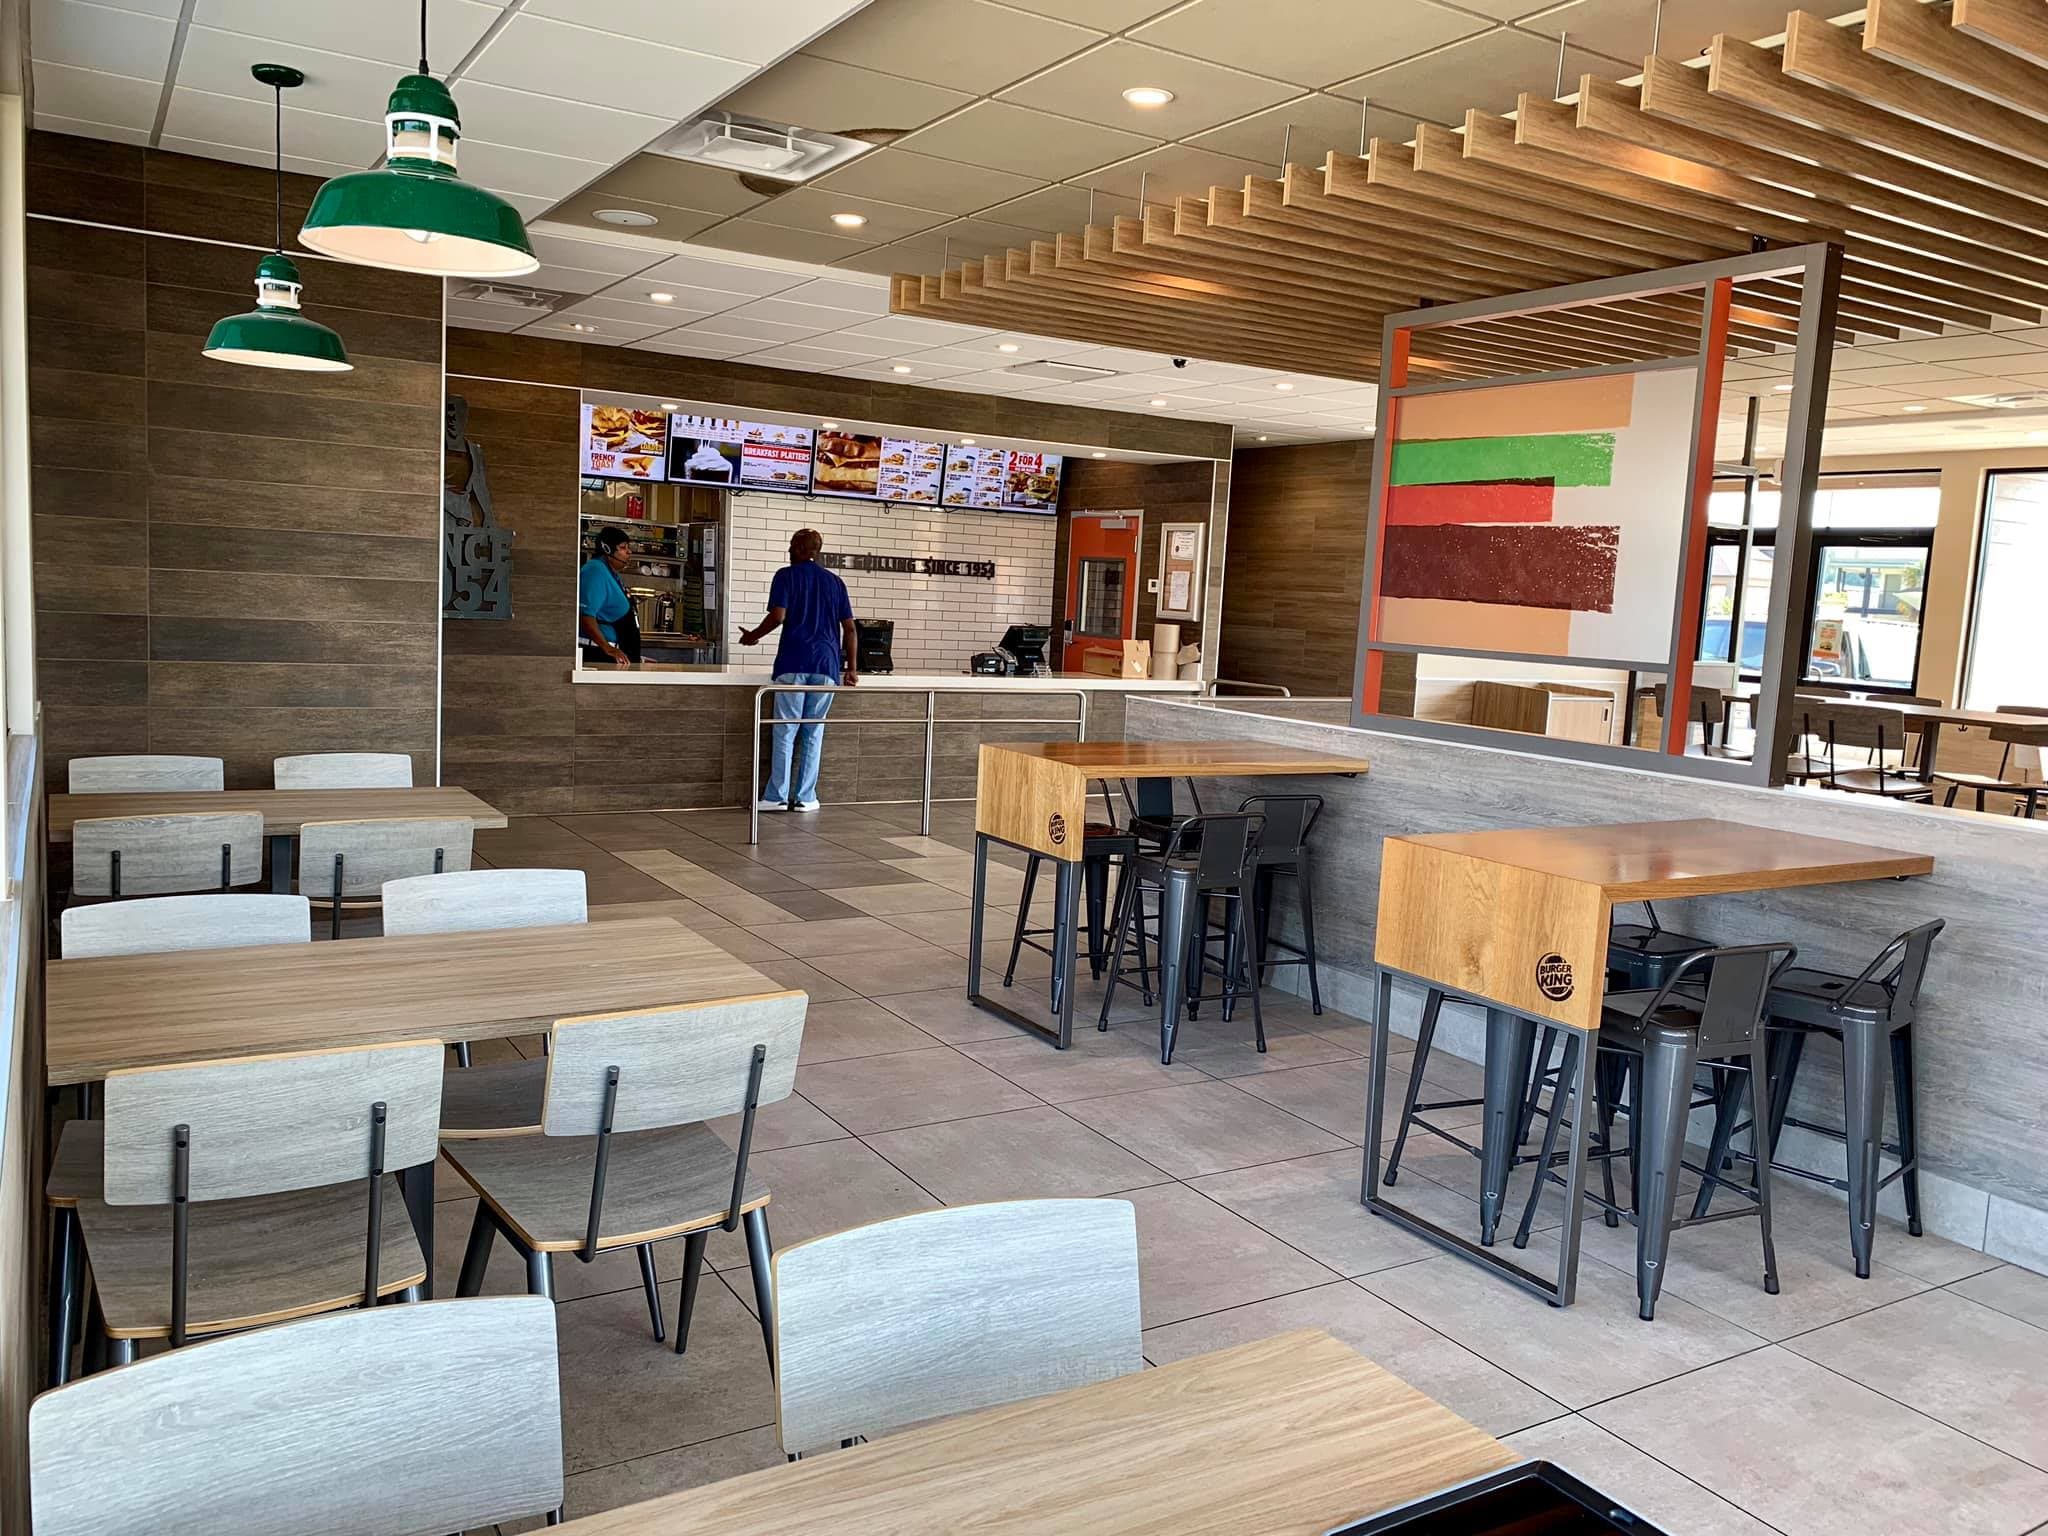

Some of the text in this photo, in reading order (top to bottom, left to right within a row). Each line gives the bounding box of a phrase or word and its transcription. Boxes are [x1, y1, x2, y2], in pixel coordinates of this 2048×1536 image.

[592, 453, 616, 462] FRENCH
[743, 447, 810, 461] BREAKFAST PLATTERS
[1009, 451, 1043, 468] 2 FOR 4
[592, 461, 614, 469] TOAST
[443, 532, 513, 568] NCE
[926, 559, 961, 575] SINCE
[443, 569, 511, 611] 54
[1540, 964, 1572, 975] BURGER
[1540, 973, 1573, 987] KING
